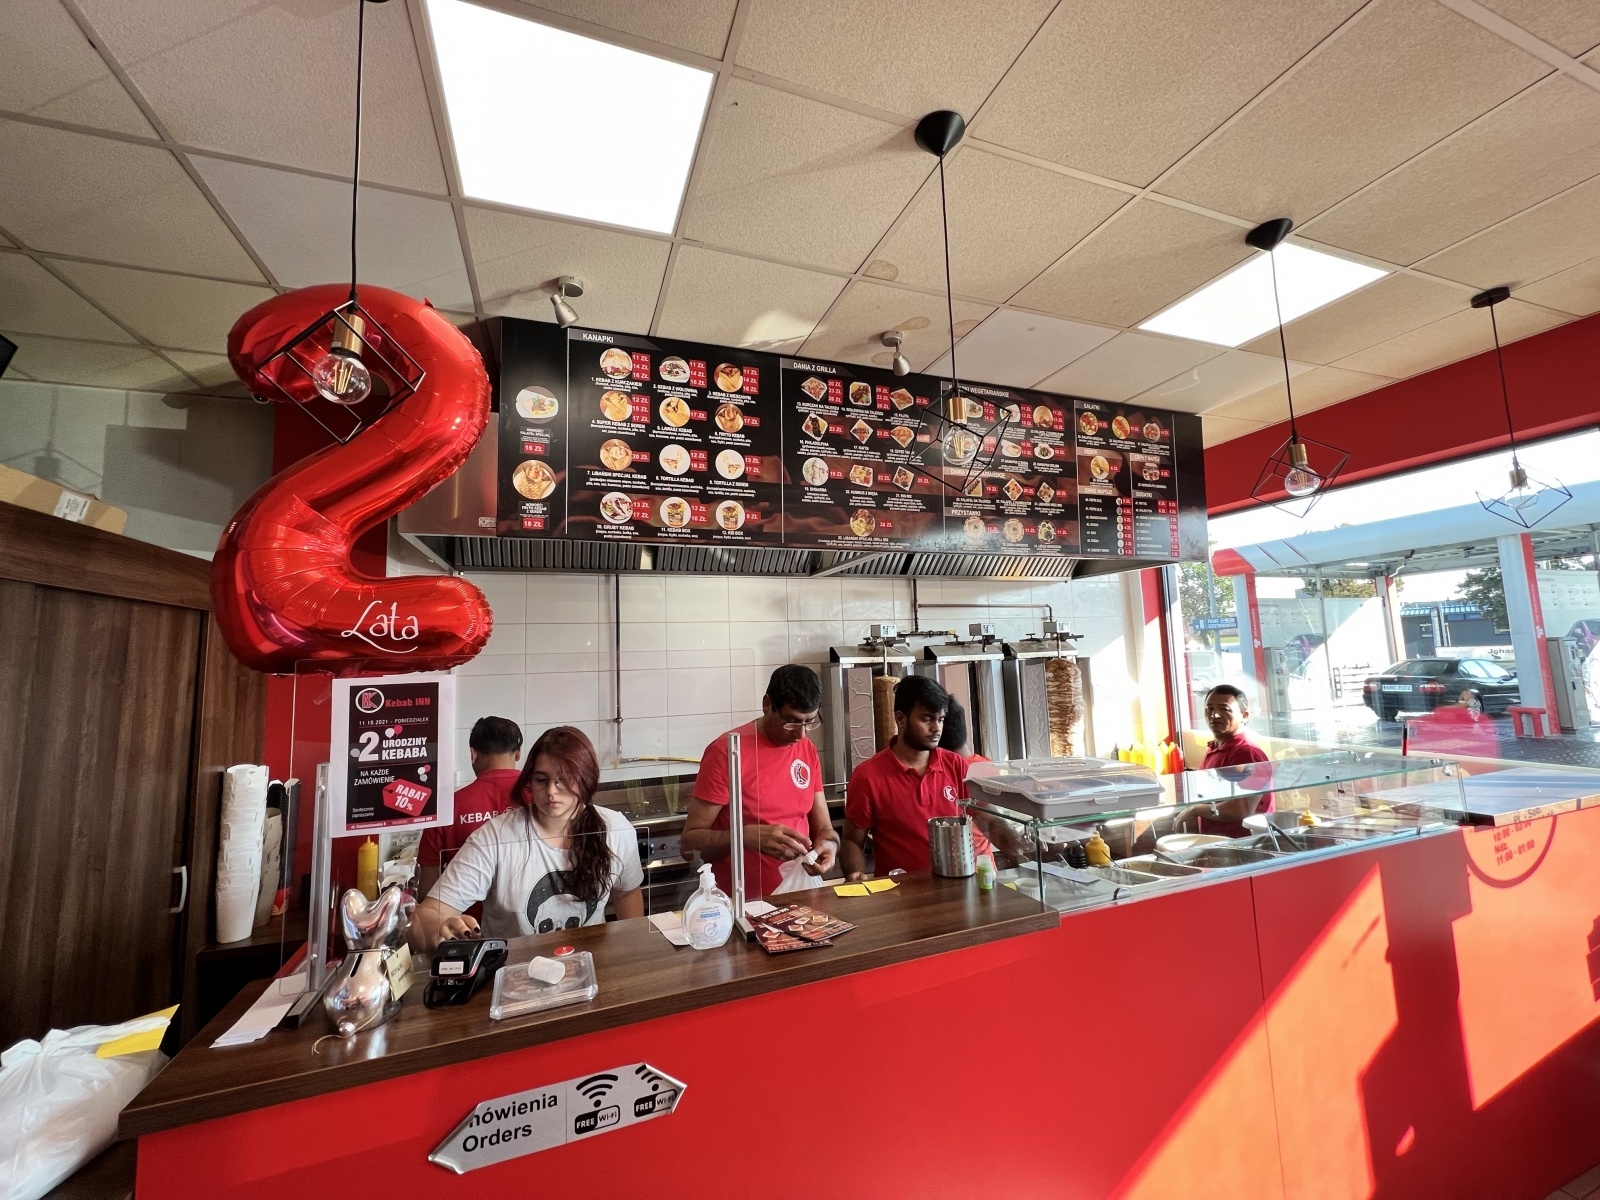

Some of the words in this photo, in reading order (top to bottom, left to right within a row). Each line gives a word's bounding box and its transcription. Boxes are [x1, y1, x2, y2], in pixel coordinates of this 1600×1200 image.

[583, 333, 614, 343] KANAPKI
[794, 362, 811, 370] DANIA
[816, 365, 836, 374] GRILLA
[341, 600, 418, 653] Lata
[385, 699, 412, 708] Kebab
[359, 731, 379, 762] 2
[383, 737, 427, 748] URODZINY
[382, 747, 427, 760] KEBABA
[354, 776, 395, 786] ZAMÓWIENIE
[395, 784, 427, 801] RABAT
[395, 796, 413, 811] 10%
[460, 812, 498, 824] KEBAB
[1496, 850, 1513, 866] 11:00
[635, 1101, 653, 1112] FREE
[657, 1095, 674, 1105] Wi-Fi
[576, 1117, 594, 1128] FREE
[599, 1111, 617, 1122] Wi-Fi
[463, 1123, 532, 1152] Orders
